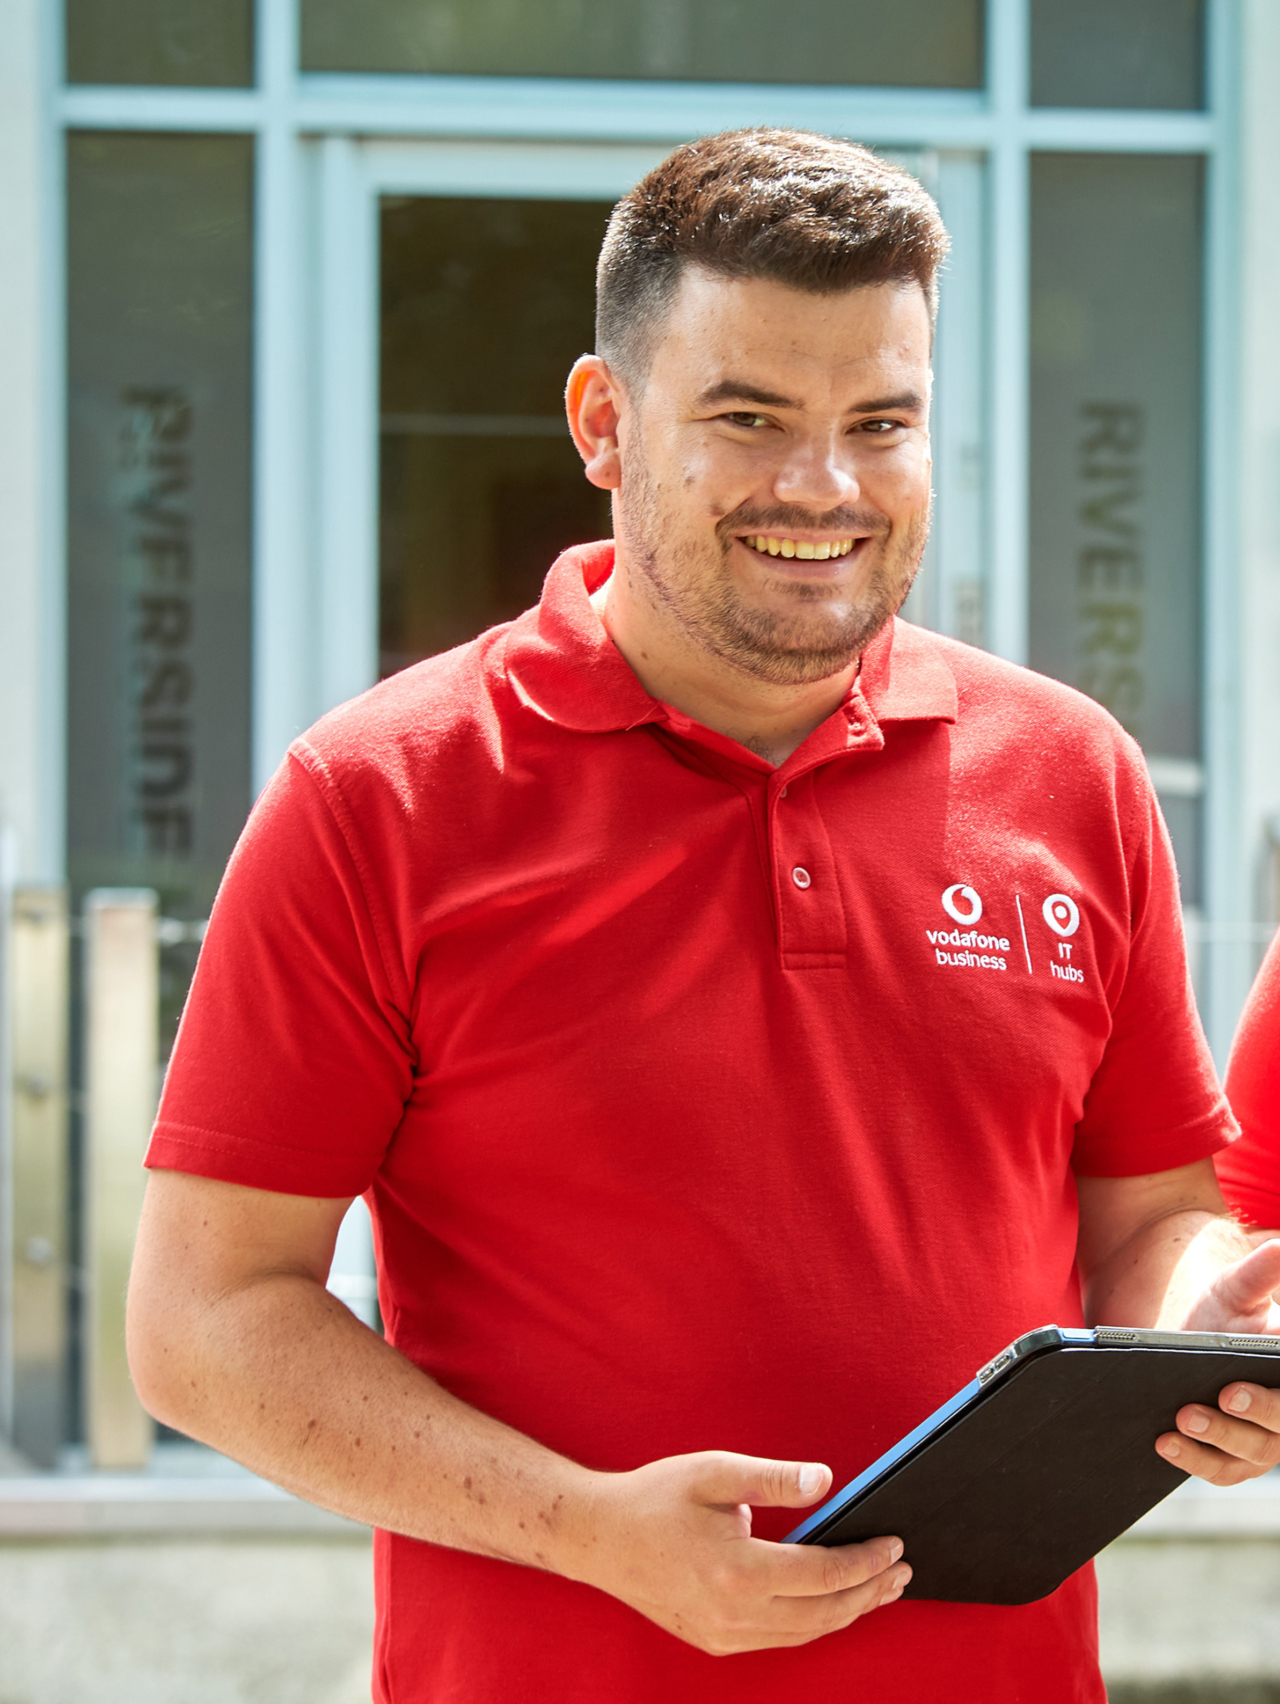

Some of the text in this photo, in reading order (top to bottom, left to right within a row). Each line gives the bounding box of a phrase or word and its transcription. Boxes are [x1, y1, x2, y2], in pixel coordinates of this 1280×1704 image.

[1077, 401, 1145, 738] RIVERS
[925, 929, 1011, 951] vodafone
[1058, 942, 1073, 960] IT
[935, 948, 1007, 971] business
[1050, 960, 1084, 983] hubs
